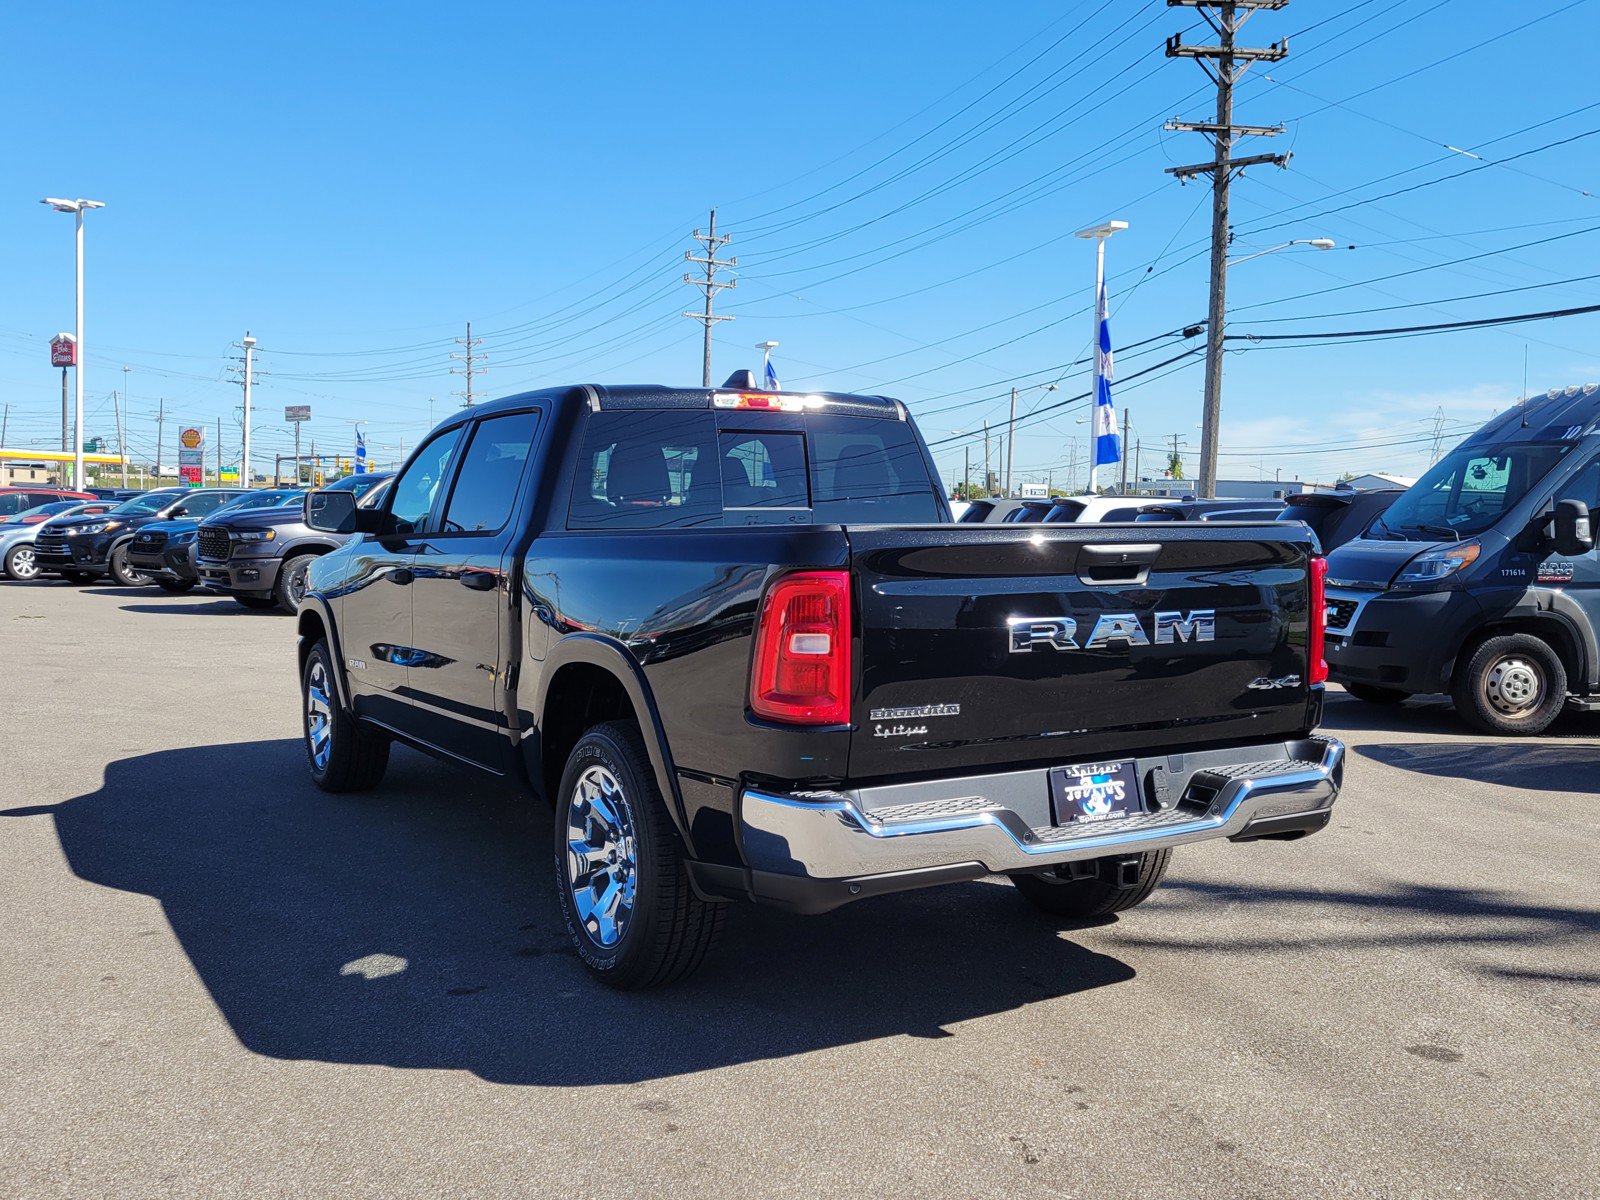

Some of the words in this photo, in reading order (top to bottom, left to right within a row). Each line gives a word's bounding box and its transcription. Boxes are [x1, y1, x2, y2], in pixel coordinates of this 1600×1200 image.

[56, 343, 68, 353] Bob
[53, 352, 72, 363] Evans
[1561, 425, 1582, 439] 10
[1501, 569, 1526, 577] 171614
[1006, 609, 1216, 654] RAM
[348, 659, 366, 670] RAM
[873, 724, 928, 738] Spitzer
[1071, 764, 1118, 779] Spitzer
[1078, 811, 1126, 824] Spitzer.com
